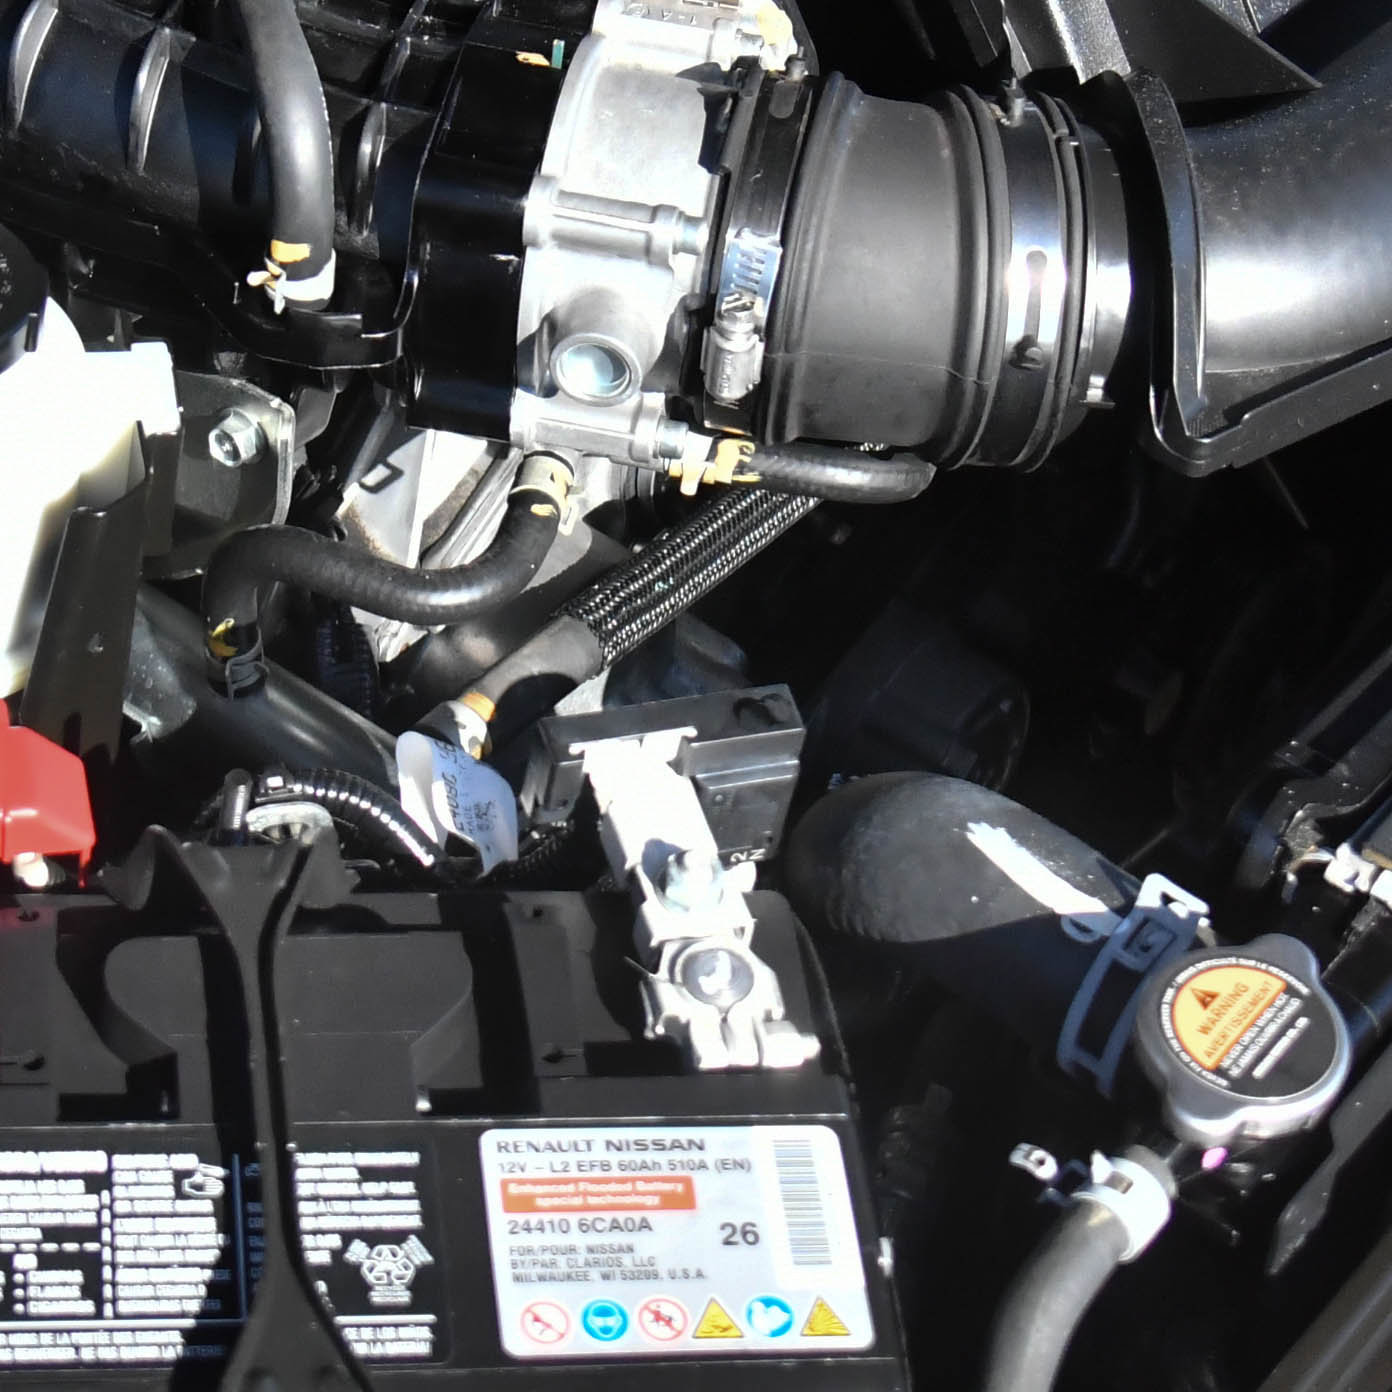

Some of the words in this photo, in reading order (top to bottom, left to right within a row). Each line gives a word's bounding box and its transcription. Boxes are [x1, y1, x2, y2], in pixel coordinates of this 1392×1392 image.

[1197, 981, 1248, 1035] WARNING
[1204, 980, 1273, 1058] AVERTISSEMENT
[496, 1138, 595, 1154] RENAULT
[606, 1138, 705, 1152] NISSAN
[498, 1161, 527, 1174] 12V
[549, 1160, 570, 1173] L2
[577, 1160, 612, 1172] EFB
[618, 1160, 661, 1172] 60Ah
[668, 1159, 709, 1172] 510A
[714, 1158, 752, 1173] (EN)
[507, 1182, 575, 1195] Enhanced
[578, 1181, 632, 1194] Flooded
[635, 1181, 685, 1195] Battery
[535, 1194, 585, 1208] special
[587, 1193, 660, 1207] technology
[507, 1218, 571, 1235] 24410
[577, 1216, 654, 1233] 6CA0A
[719, 1221, 760, 1246] 26
[586, 1242, 635, 1255] NISSAN
[632, 1256, 656, 1267] LLC
[600, 1270, 618, 1282] WI
